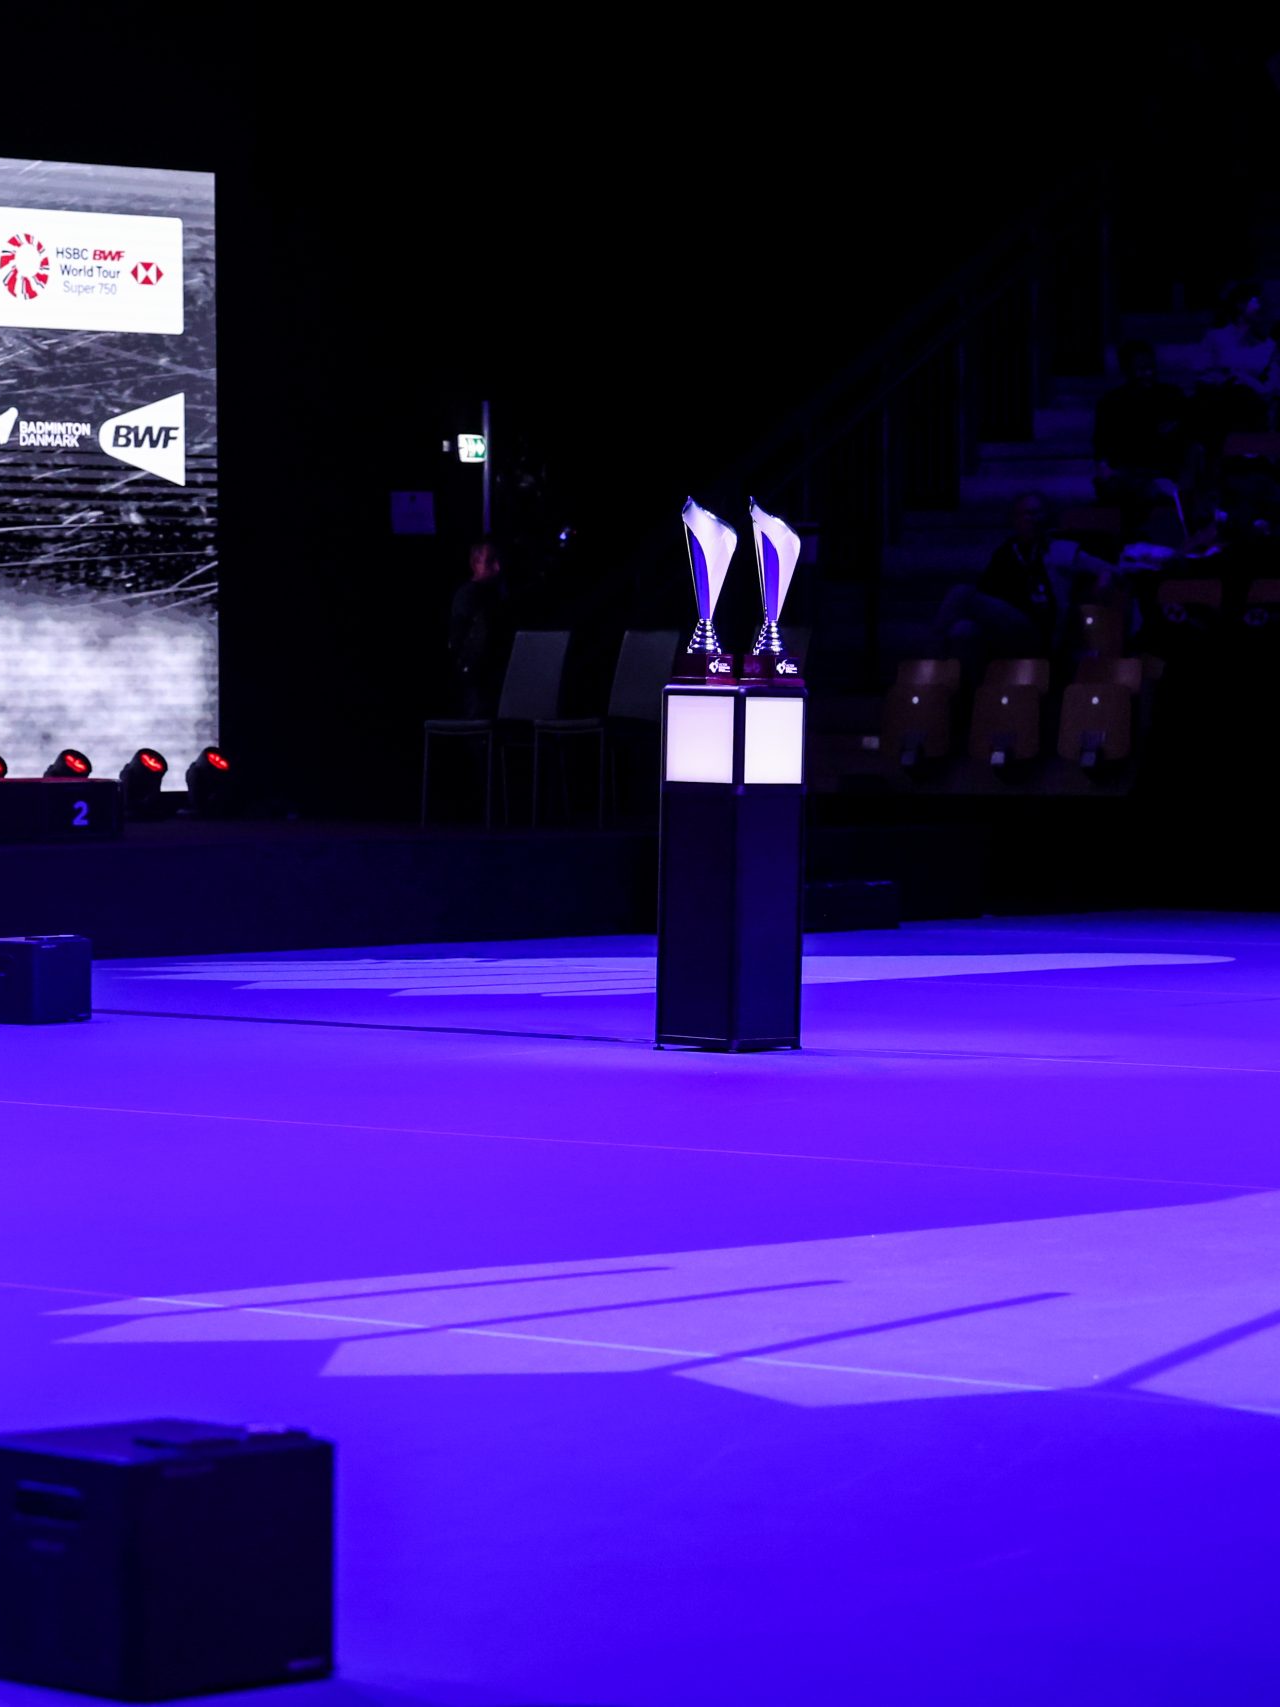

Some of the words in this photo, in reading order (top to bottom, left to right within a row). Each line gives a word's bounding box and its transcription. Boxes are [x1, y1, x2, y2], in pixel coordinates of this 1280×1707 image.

[56, 247, 89, 260] HSBC
[92, 249, 125, 262] BWF
[60, 264, 93, 278] World
[96, 266, 120, 279] Tour
[63, 281, 95, 296] Super
[99, 283, 117, 295] 750
[19, 421, 91, 437] BADMINTON
[112, 424, 179, 449] BWF
[19, 434, 80, 448] DANMARK
[72, 800, 90, 826] 2
